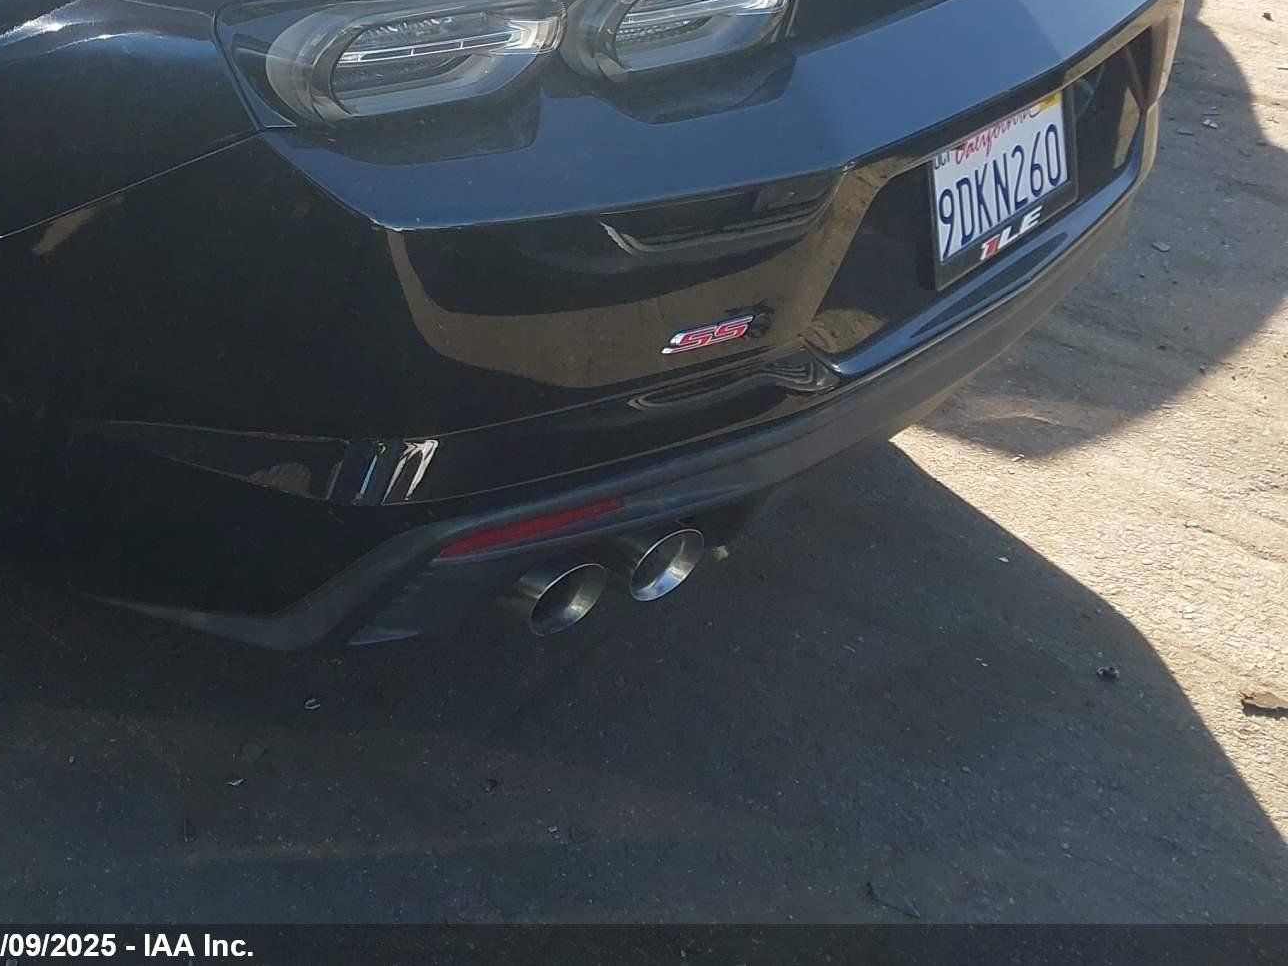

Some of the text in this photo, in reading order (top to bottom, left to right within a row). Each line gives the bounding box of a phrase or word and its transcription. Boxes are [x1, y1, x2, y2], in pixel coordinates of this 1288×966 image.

[938, 123, 1062, 259] 9DKN260
[980, 205, 1043, 261] 1LE
[661, 315, 754, 354] SS
